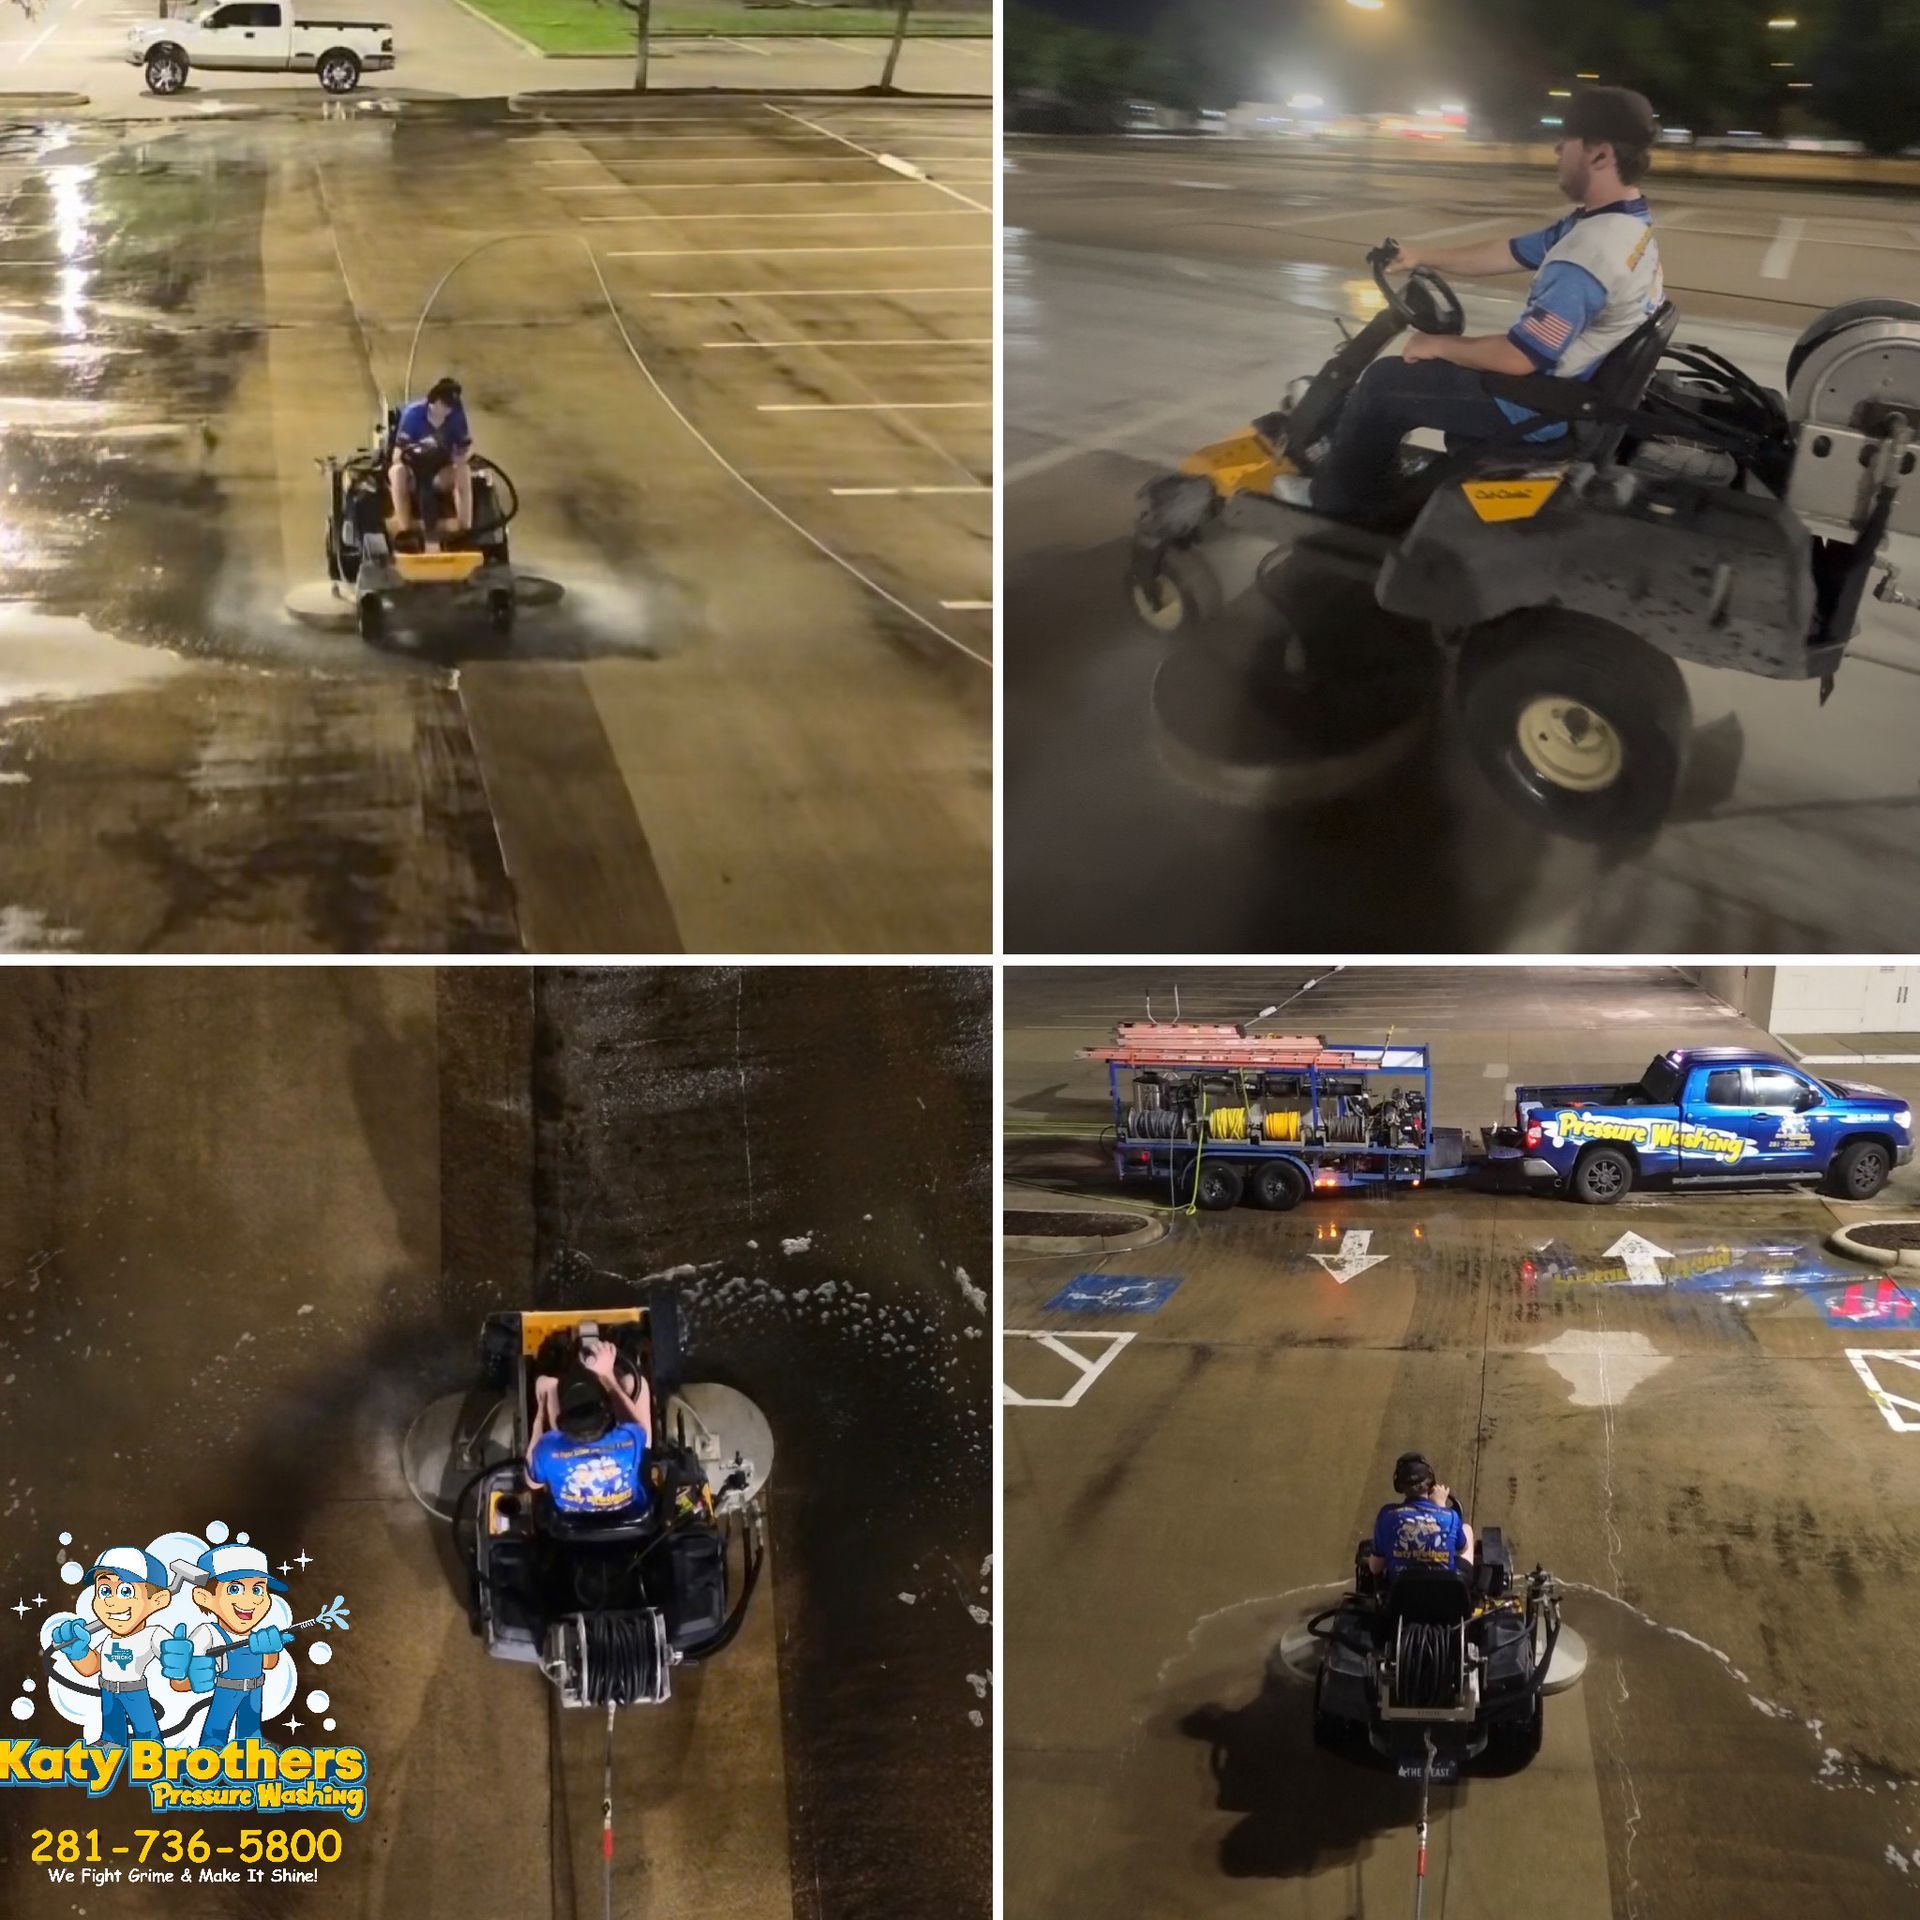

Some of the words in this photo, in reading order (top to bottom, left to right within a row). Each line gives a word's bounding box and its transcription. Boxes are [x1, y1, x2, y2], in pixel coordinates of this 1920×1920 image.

[1558, 1111, 1648, 1144] Pressure
[1651, 1122, 1745, 1164] Washing
[1407, 1767, 1421, 1777] THE
